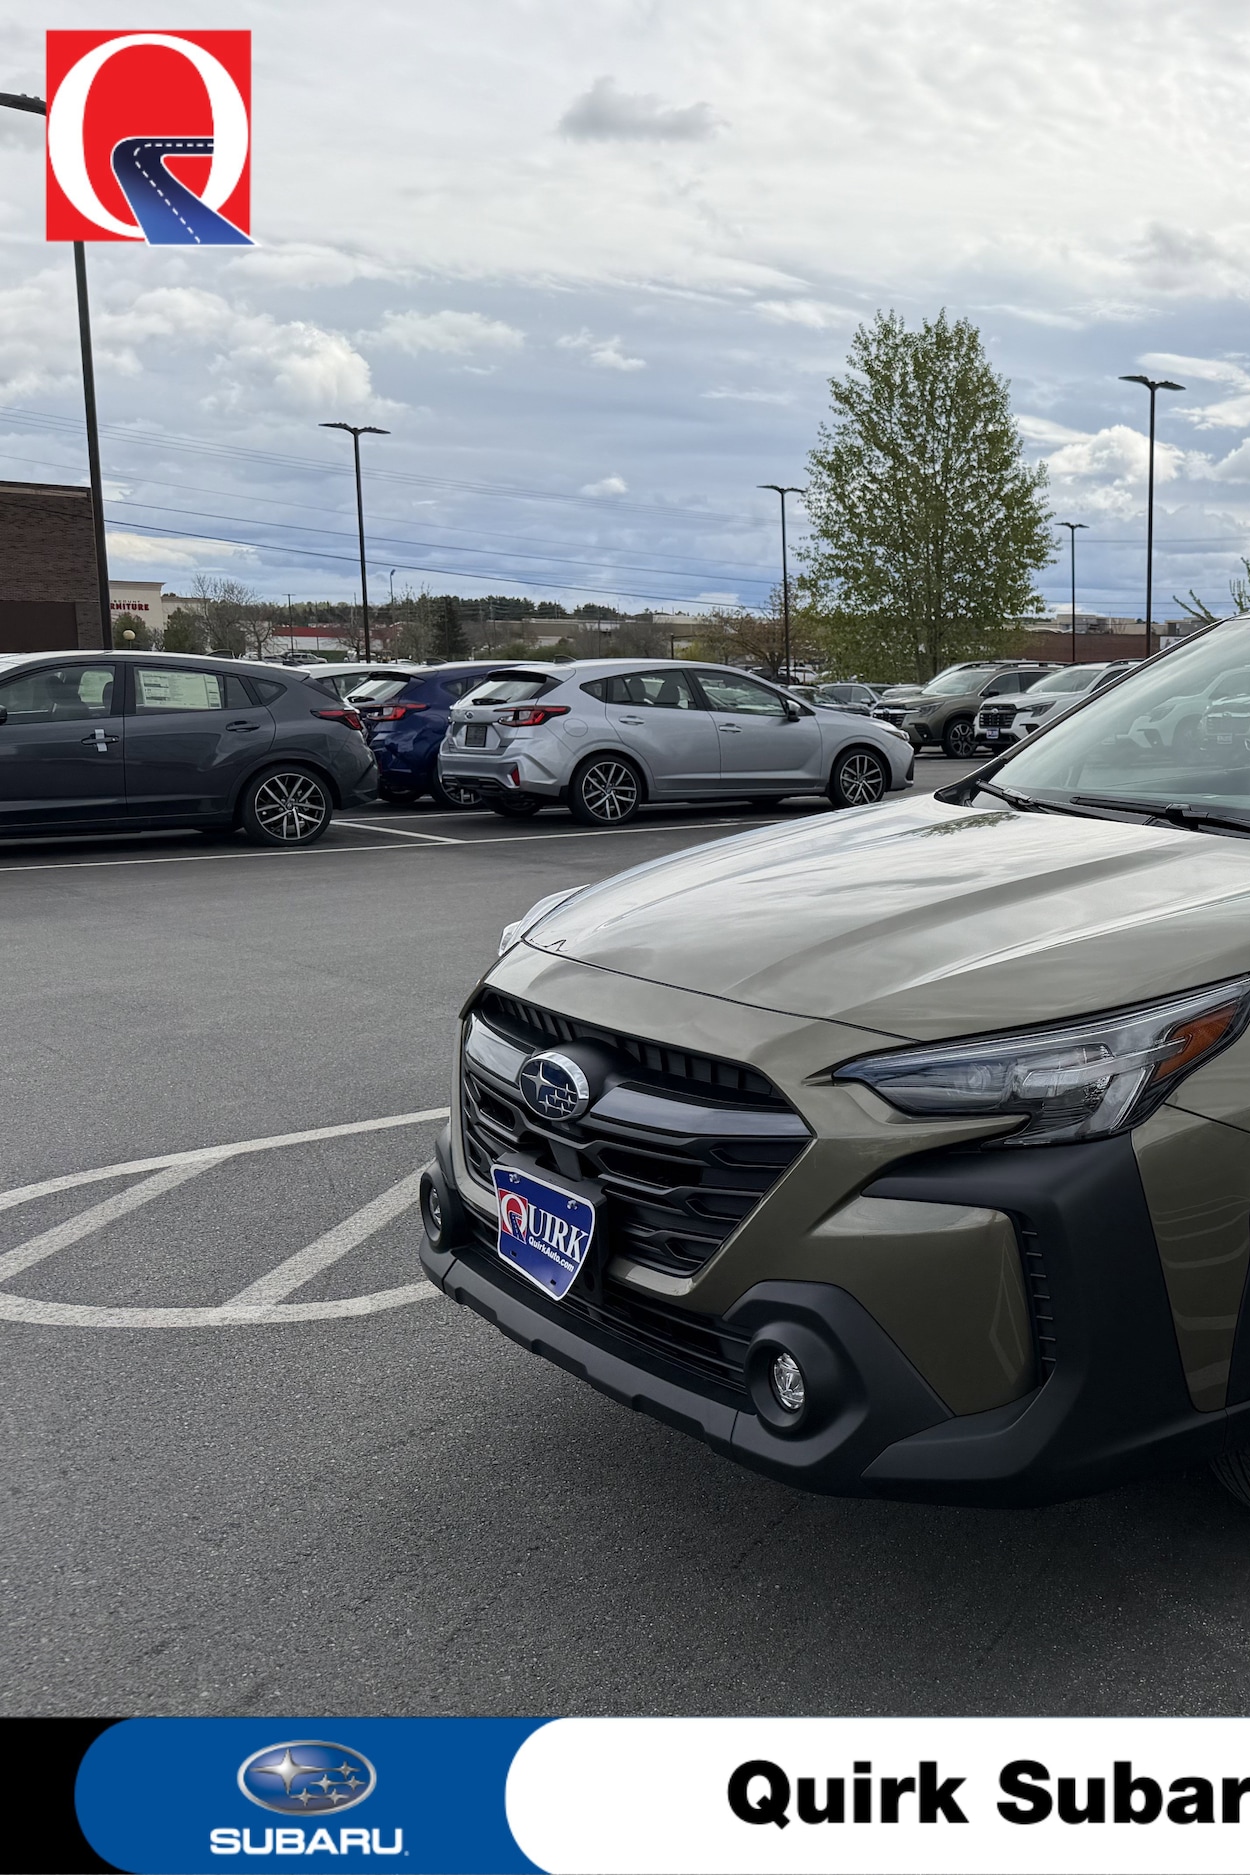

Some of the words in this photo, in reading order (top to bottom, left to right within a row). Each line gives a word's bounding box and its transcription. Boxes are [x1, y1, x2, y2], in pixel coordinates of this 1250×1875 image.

[110, 603, 149, 611] RNITURE
[500, 1193, 588, 1263] QUIRK
[528, 1235, 575, 1273] QuirkAuto.com
